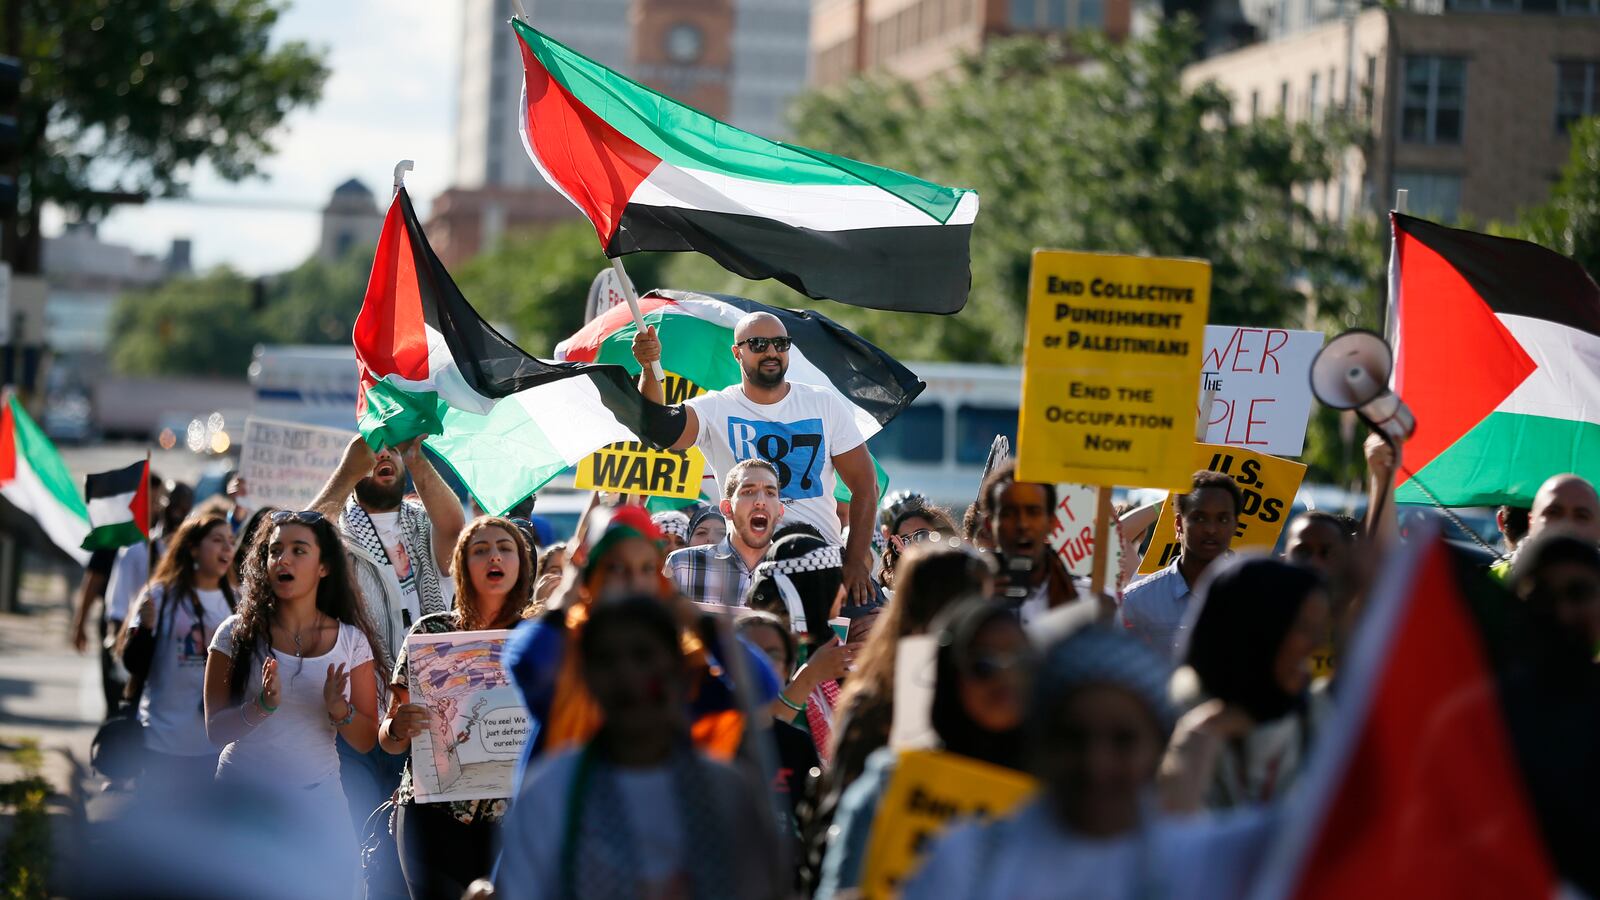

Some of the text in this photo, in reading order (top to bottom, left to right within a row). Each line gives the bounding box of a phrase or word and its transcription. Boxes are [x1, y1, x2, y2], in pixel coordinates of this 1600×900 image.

[1200, 328, 1288, 374] WER
[1207, 399, 1276, 445] PLE
[593, 452, 691, 494] WAR!
[1241, 488, 1284, 523] DS
[482, 718, 497, 726] You
[486, 729, 499, 739] just
